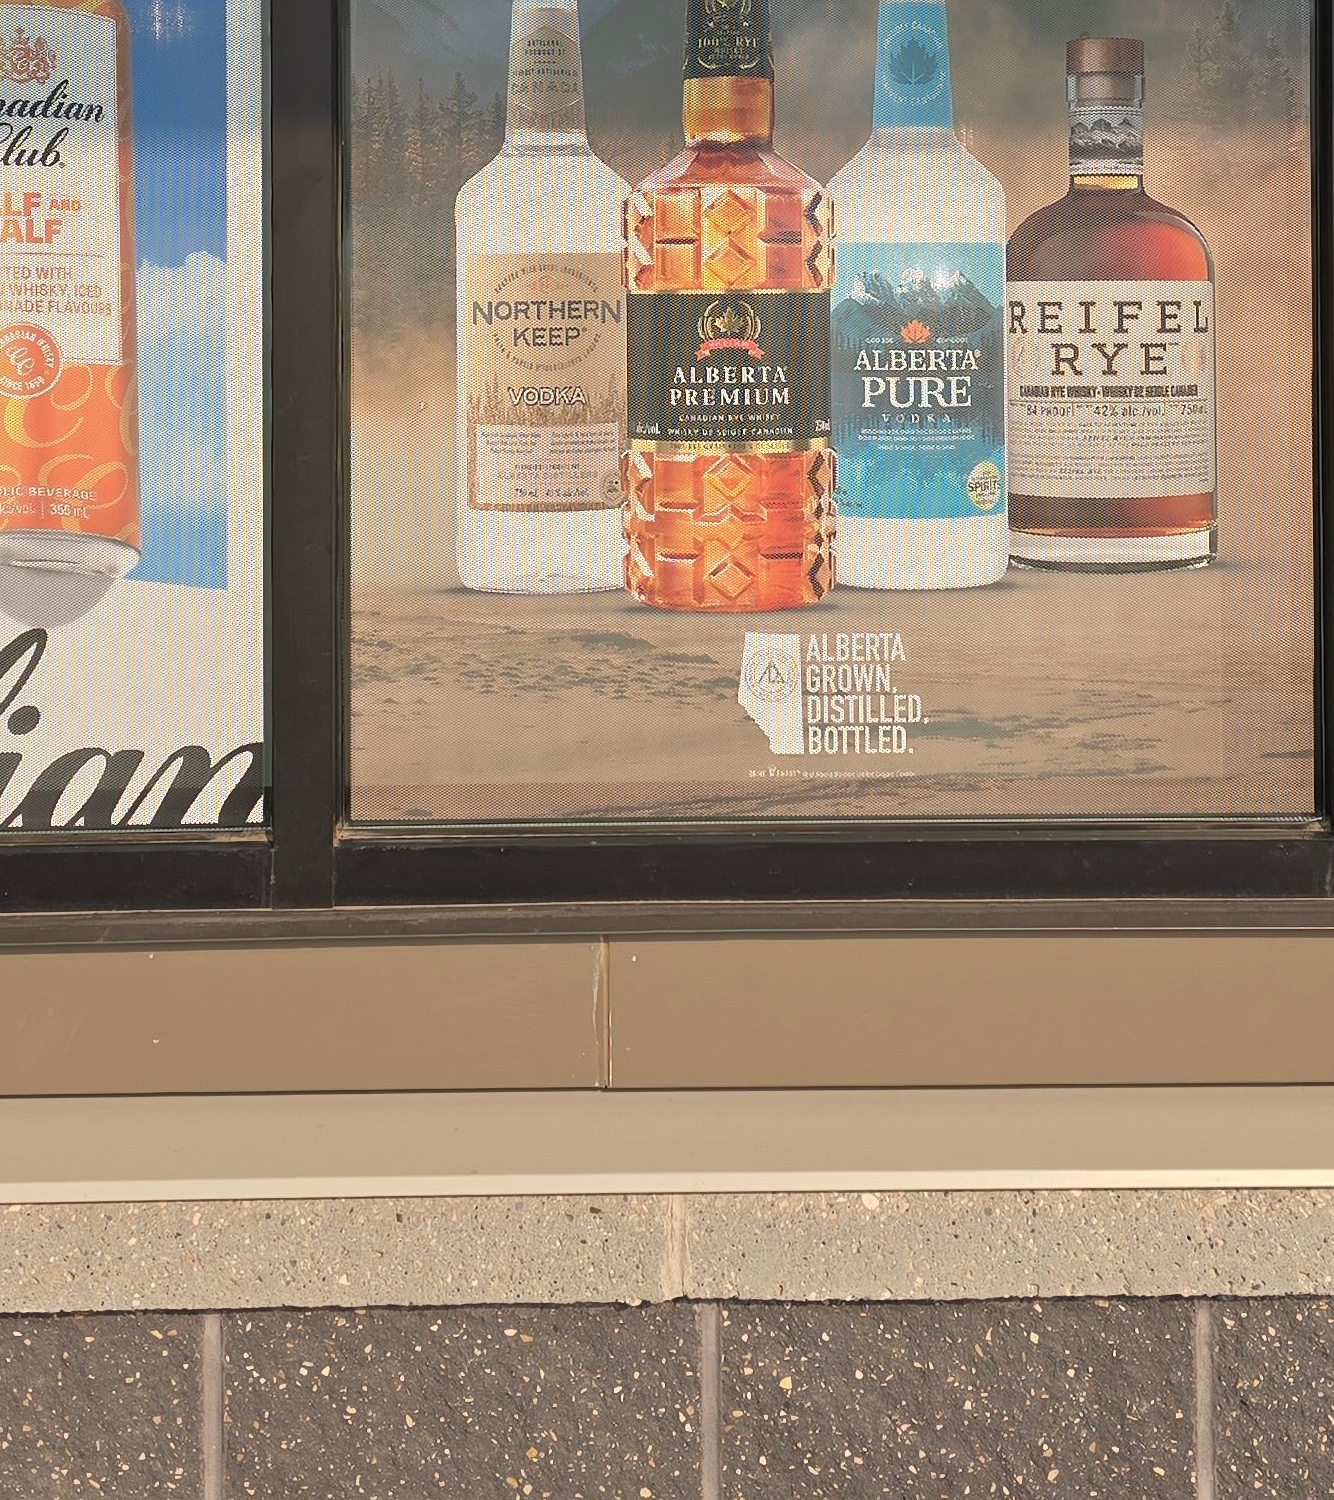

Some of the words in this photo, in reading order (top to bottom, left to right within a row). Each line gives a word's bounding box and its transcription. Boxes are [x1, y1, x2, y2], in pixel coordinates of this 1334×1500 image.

[35, 265, 73, 280] WITH
[472, 300, 621, 325] NORTHERN
[1008, 300, 1209, 334] REIFEL
[513, 326, 581, 348] KEEP
[853, 349, 979, 372] ALBERTA
[1051, 342, 1169, 376] RYE
[672, 365, 788, 385] ALBERTA
[507, 386, 587, 406] VODKA
[668, 387, 791, 407] PREMIUM
[861, 375, 972, 409] PURE
[880, 413, 952, 424] VODKA
[27, 486, 98, 502] BEVERAGE
[805, 632, 906, 663] ALBERTA
[805, 663, 898, 694] GROWN,
[807, 694, 930, 725] DISTILLED,
[808, 725, 914, 755] BOTTLED.
